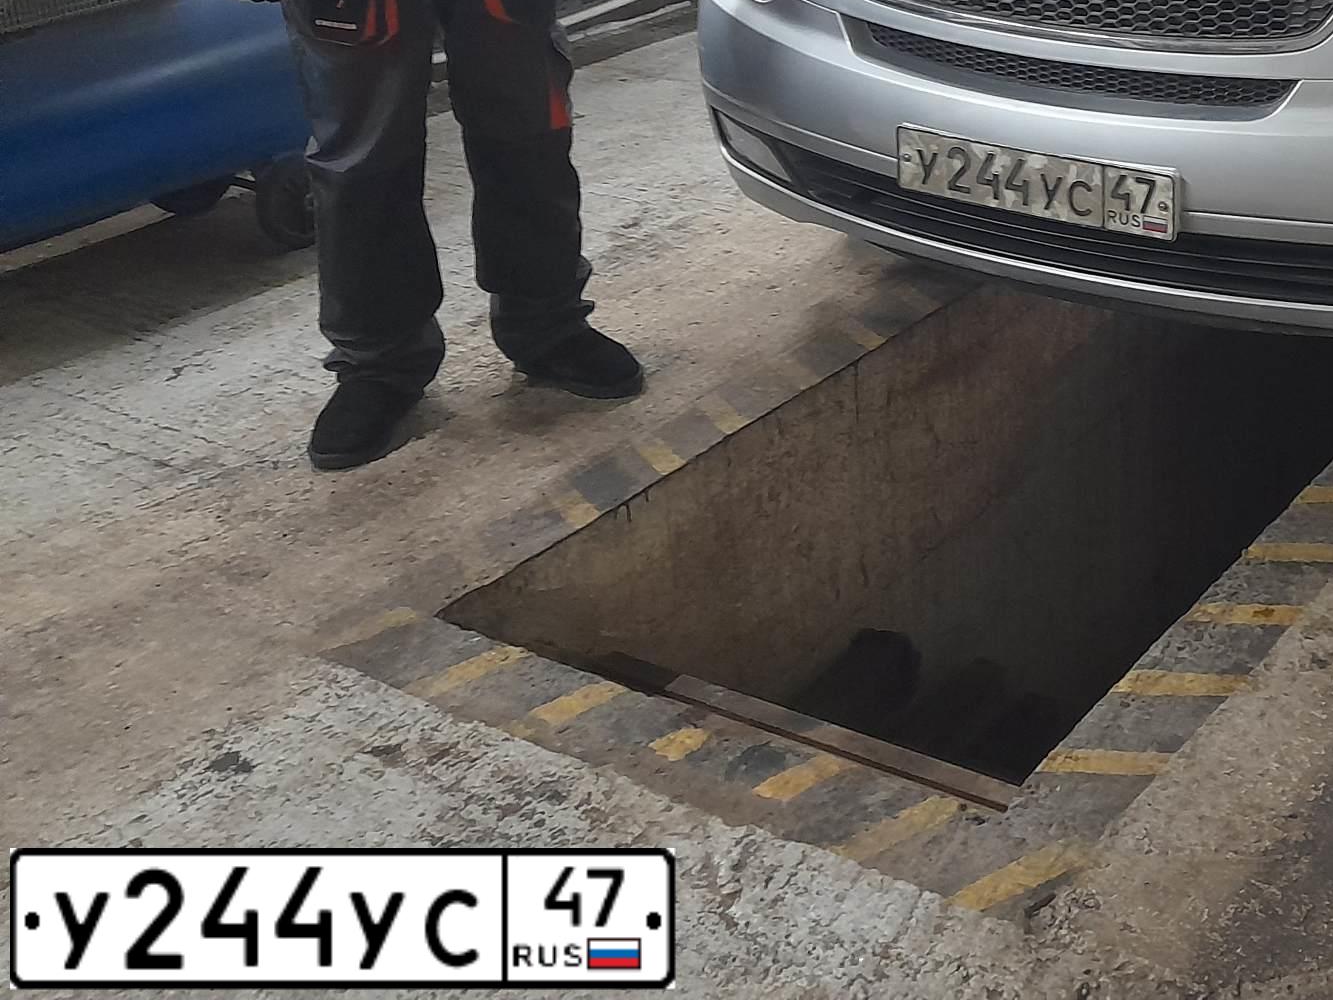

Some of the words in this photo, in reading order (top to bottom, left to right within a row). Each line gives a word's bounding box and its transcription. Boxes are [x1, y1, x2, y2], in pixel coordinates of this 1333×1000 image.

[916, 145, 1093, 217] У244УС
[1110, 174, 1157, 214] 47
[1106, 210, 1141, 228] RUS
